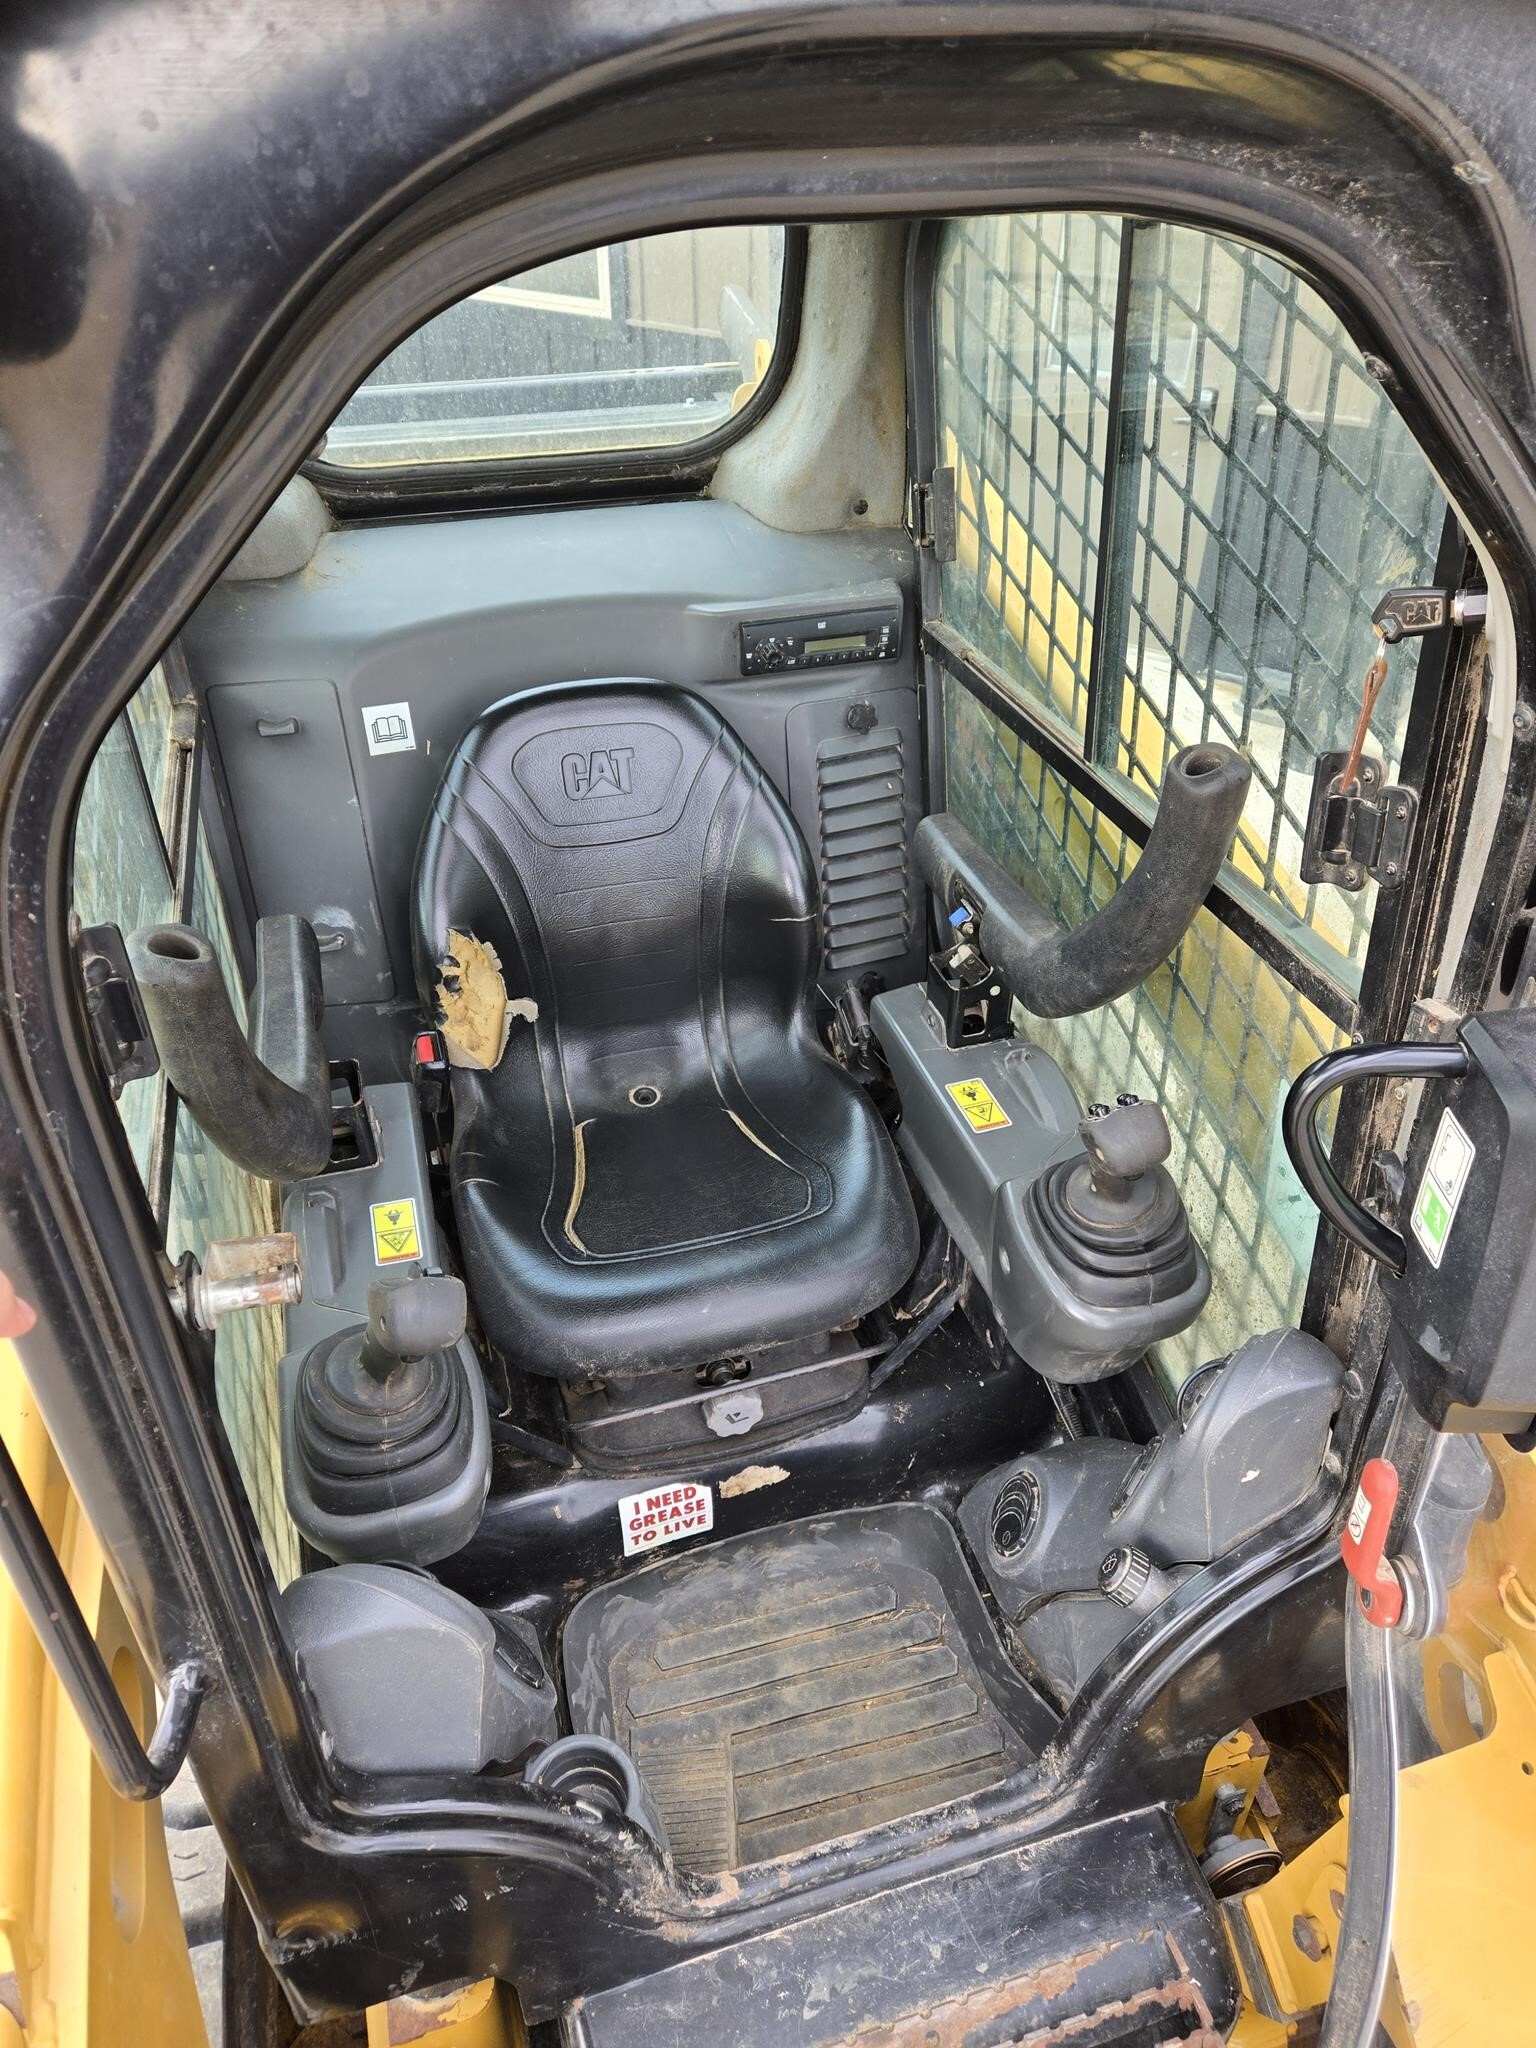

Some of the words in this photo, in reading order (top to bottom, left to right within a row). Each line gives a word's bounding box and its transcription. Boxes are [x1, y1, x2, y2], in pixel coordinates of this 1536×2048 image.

[1401, 600, 1440, 625] CAT
[561, 747, 635, 801] CAT
[629, 1498, 706, 1531] GREASE
[633, 1502, 641, 1515] I
[646, 1486, 697, 1512] NEED
[631, 1530, 657, 1546] TO
[664, 1514, 707, 1536] LIVE
